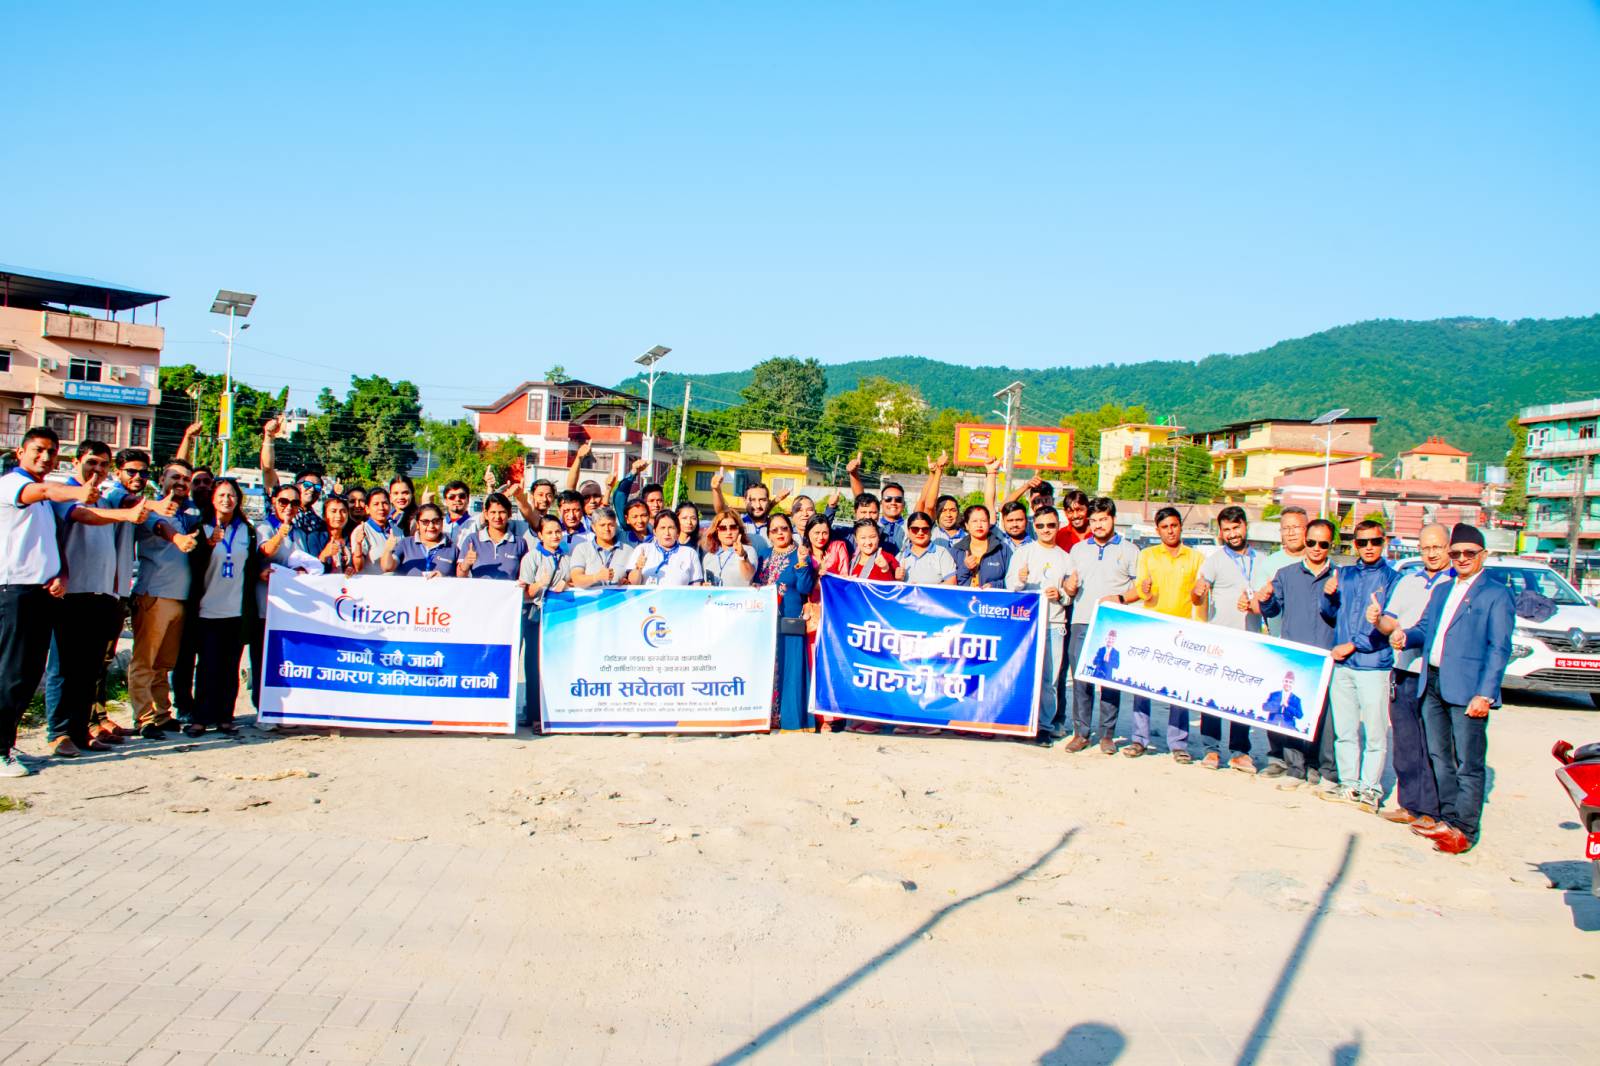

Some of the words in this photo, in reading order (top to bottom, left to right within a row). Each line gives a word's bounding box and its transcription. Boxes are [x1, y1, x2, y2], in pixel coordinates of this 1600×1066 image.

[335, 588, 409, 625] Citizen
[415, 606, 452, 626] Life
[968, 595, 1009, 616] Citizen
[1011, 605, 1031, 618] Life
[414, 626, 450, 634] Insurance
[847, 621, 927, 657] जीव
[1174, 630, 1206, 653] Citizen
[1207, 644, 1224, 656] Life
[380, 649, 405, 666] सबै
[279, 661, 313, 679] बीमा
[317, 667, 374, 684] जागरण
[377, 669, 457, 688] अभियानमा
[570, 678, 611, 697] बीमा
[618, 677, 685, 698] सचेतना
[853, 662, 935, 698] जरुरी
